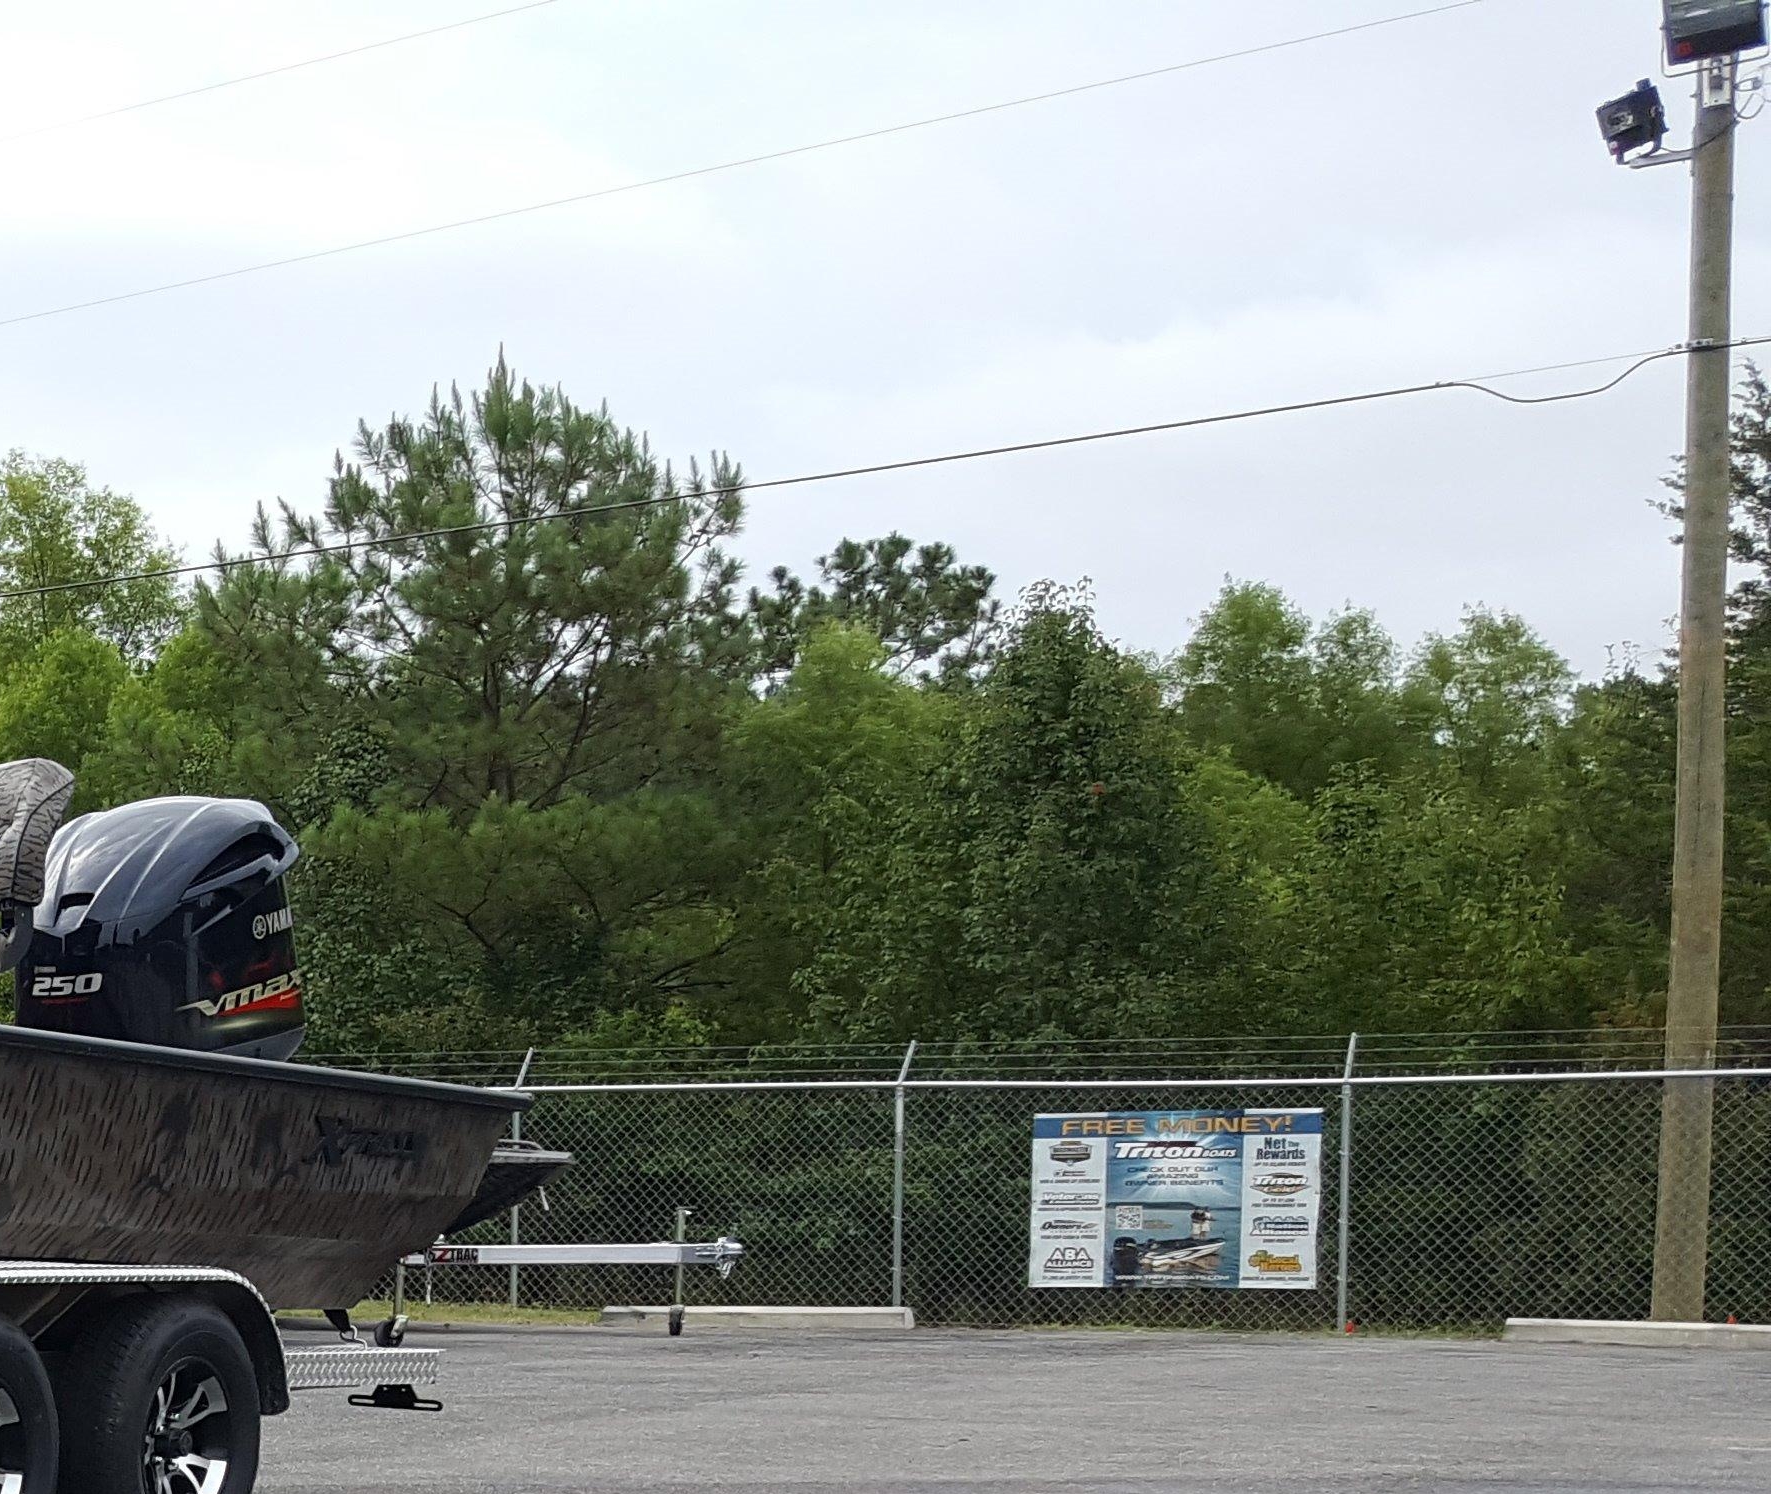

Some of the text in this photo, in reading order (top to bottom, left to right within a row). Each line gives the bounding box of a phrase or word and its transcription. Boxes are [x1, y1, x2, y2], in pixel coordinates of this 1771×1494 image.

[265, 905, 293, 935] YAMA
[32, 972, 103, 996] 250
[1061, 1115, 1292, 1136] FREE MONEY!
[1264, 1137, 1287, 1151] Net
[1256, 1148, 1306, 1160] Rewards
[1051, 1247, 1089, 1260] ABA
[1045, 1260, 1093, 1268] ALLIANCE
